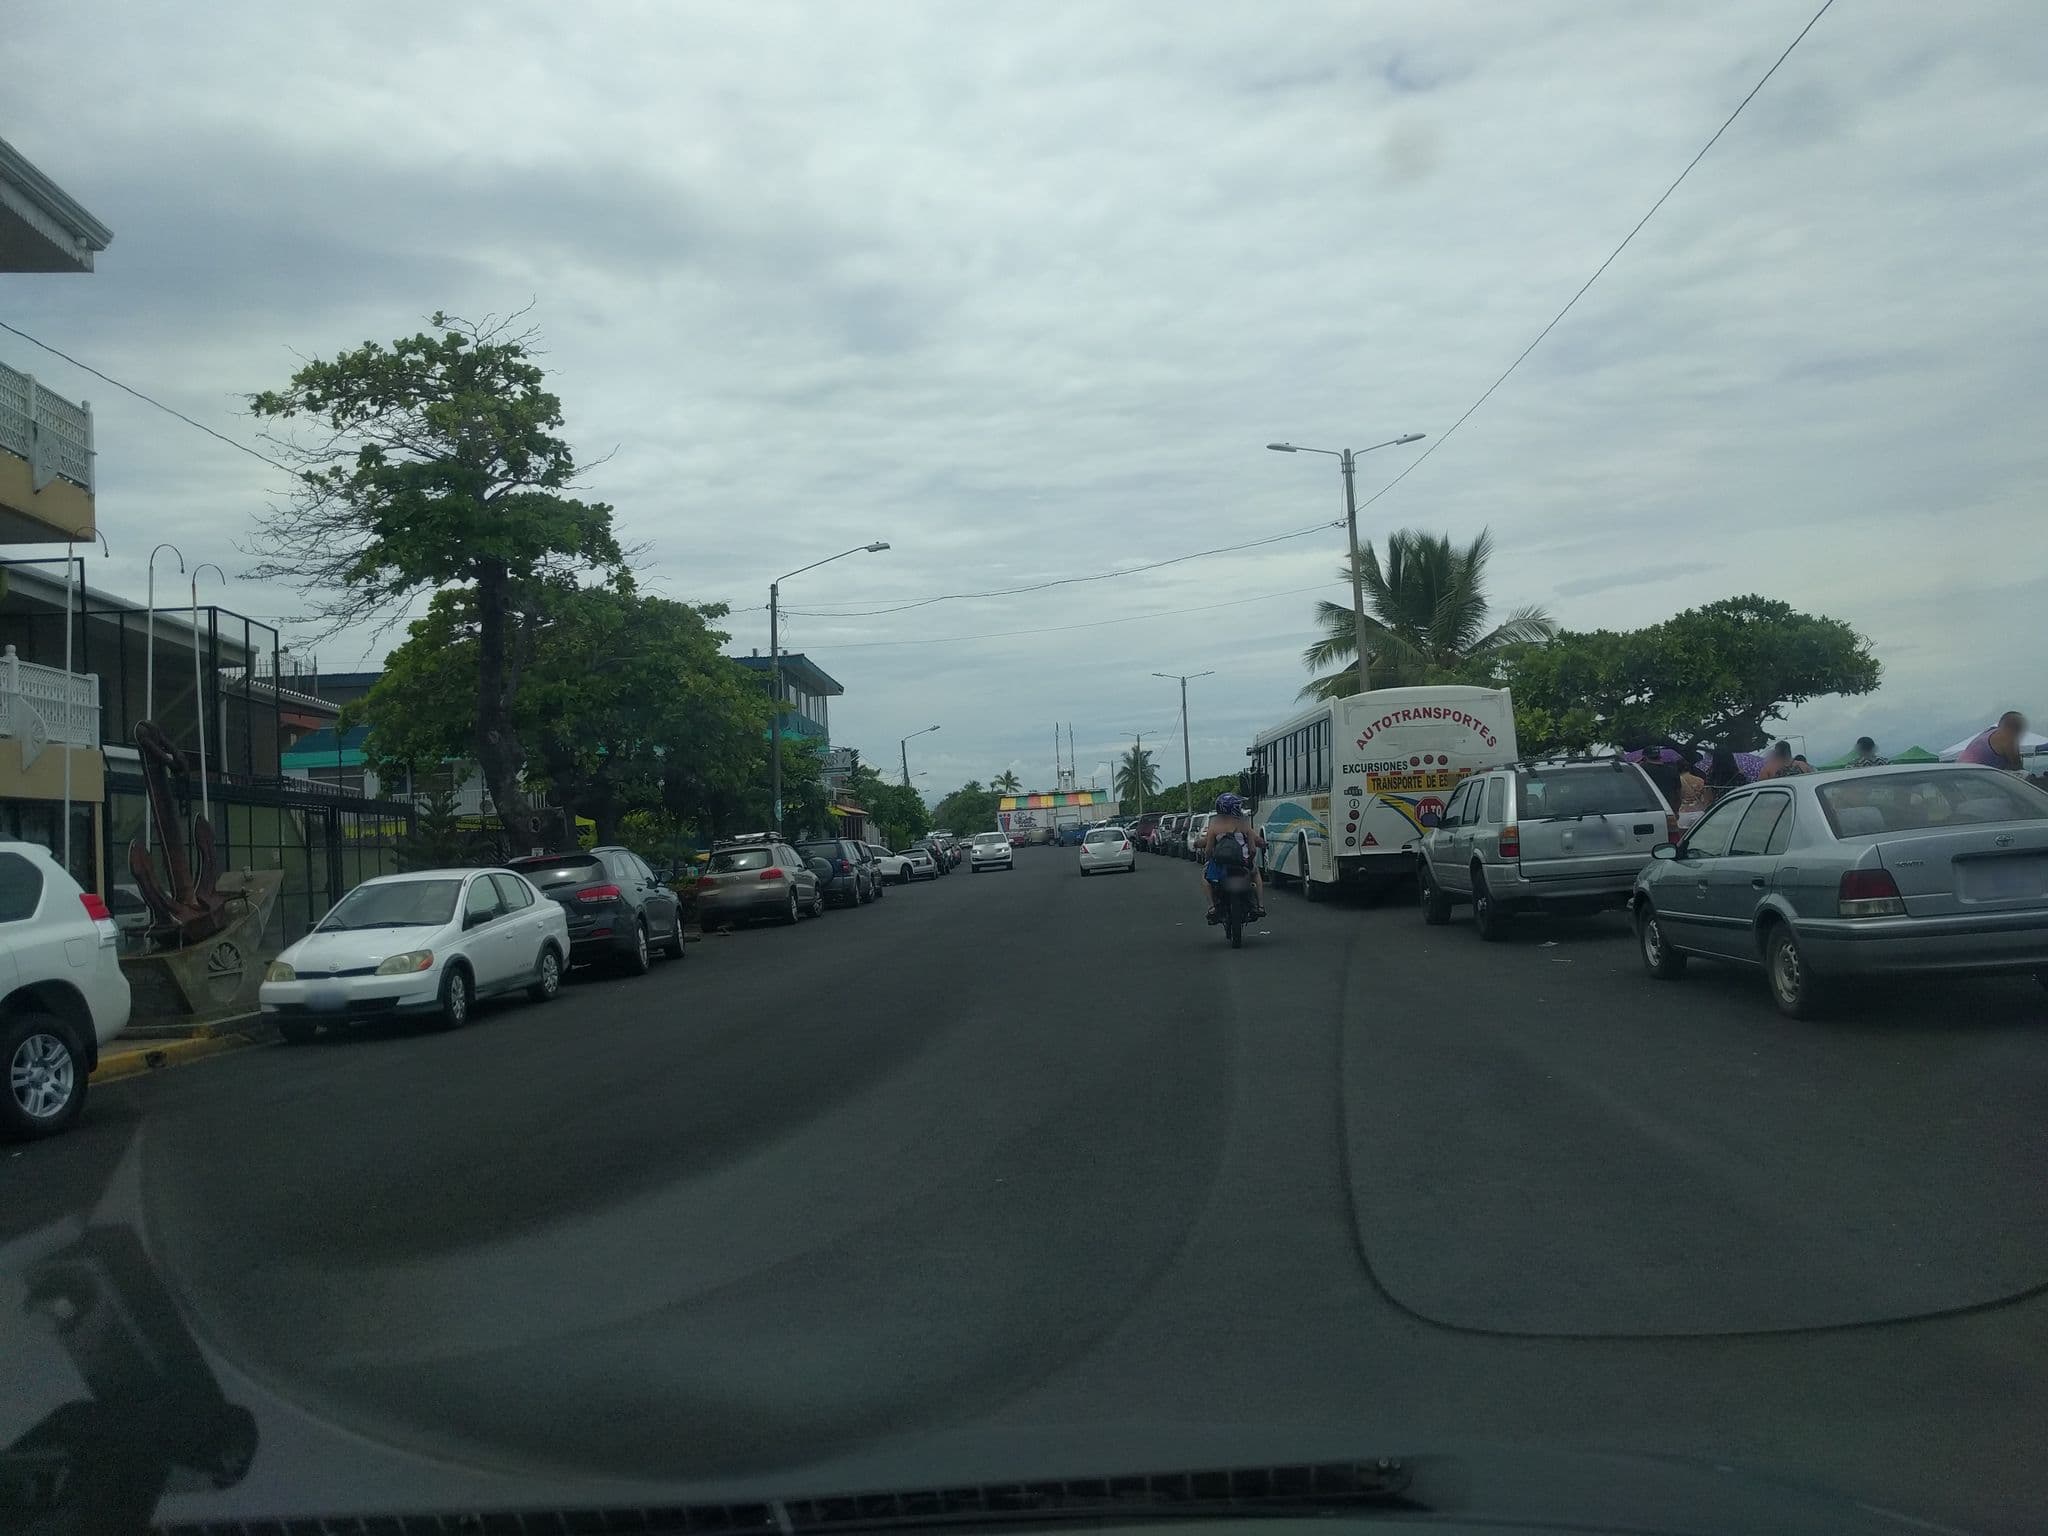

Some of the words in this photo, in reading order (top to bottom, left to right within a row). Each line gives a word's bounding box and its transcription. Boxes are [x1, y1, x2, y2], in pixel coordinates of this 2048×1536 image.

[1356, 707, 1497, 750] AUTOTRANSPORTES
[1343, 761, 1408, 774] EXCURSIONES
[1371, 776, 1422, 791] TRANSPORTE
[1426, 775, 1436, 788] DE
[1419, 805, 1442, 819] ALTO
